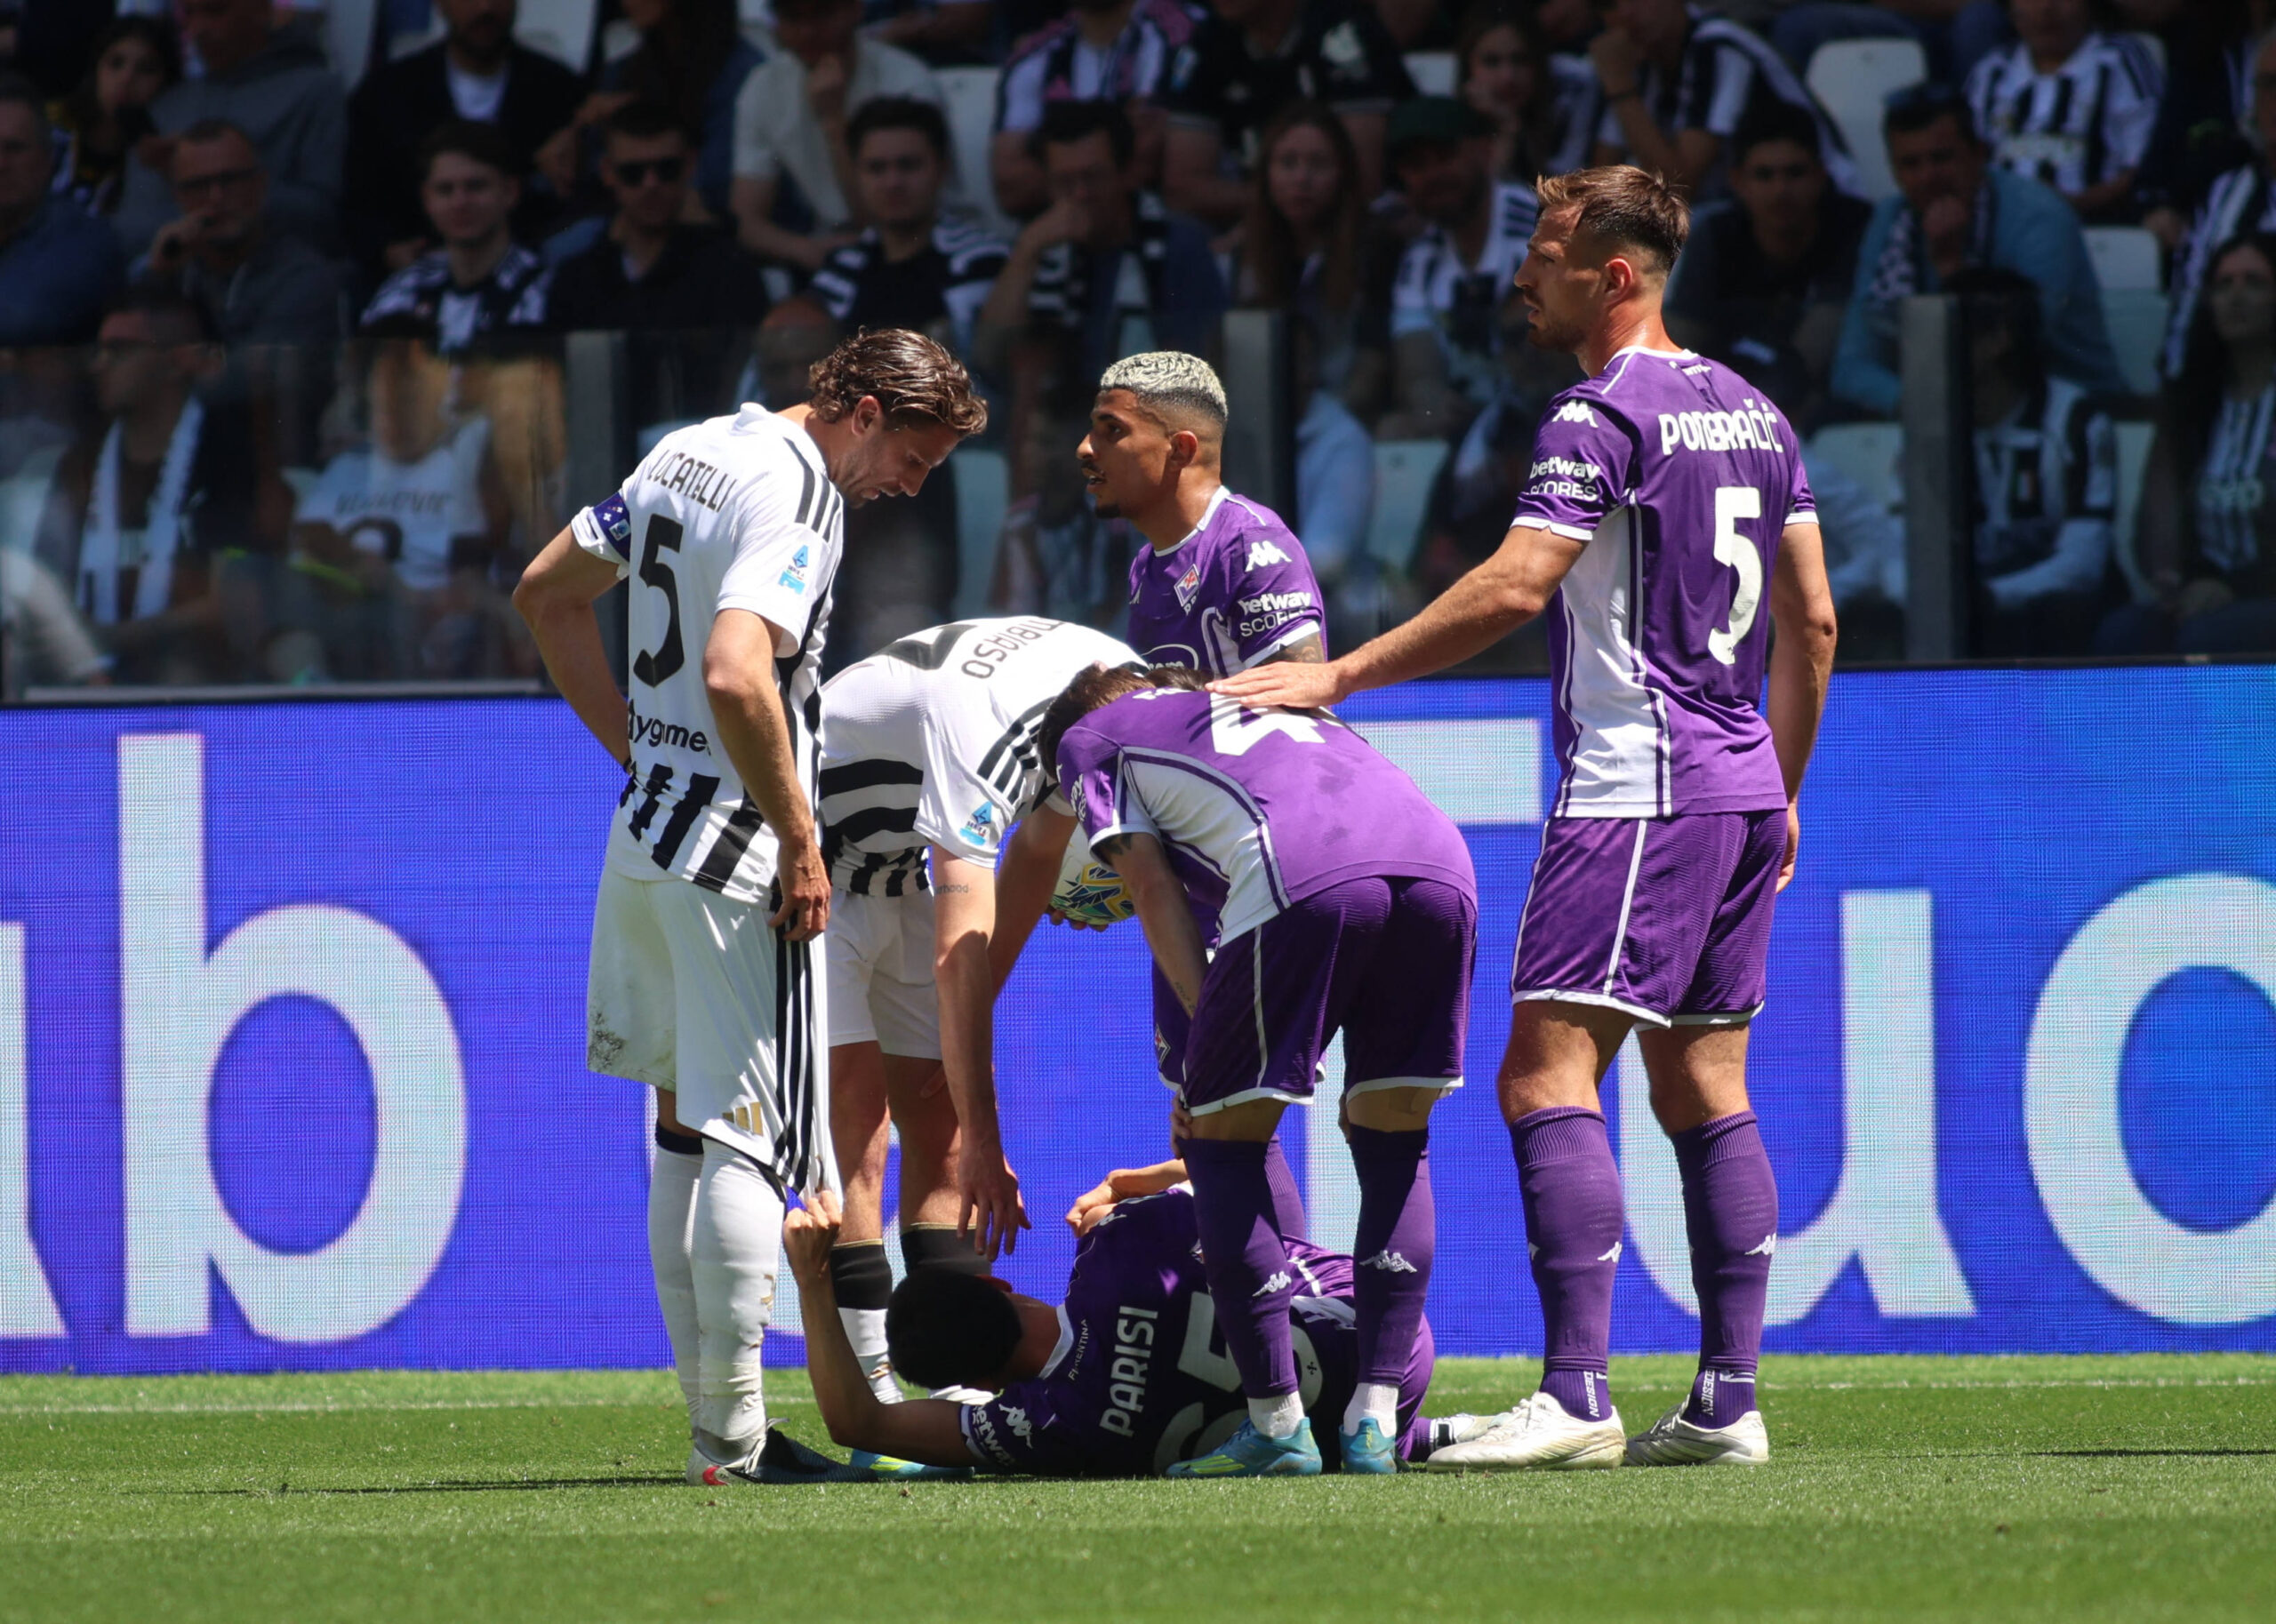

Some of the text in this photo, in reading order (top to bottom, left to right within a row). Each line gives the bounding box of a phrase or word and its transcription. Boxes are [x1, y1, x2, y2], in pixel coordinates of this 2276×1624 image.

[1529, 456, 1601, 483] betway
[633, 512, 685, 688] 5
[1708, 486, 1763, 666] 5
[1099, 1306, 1158, 1437] PARISI
